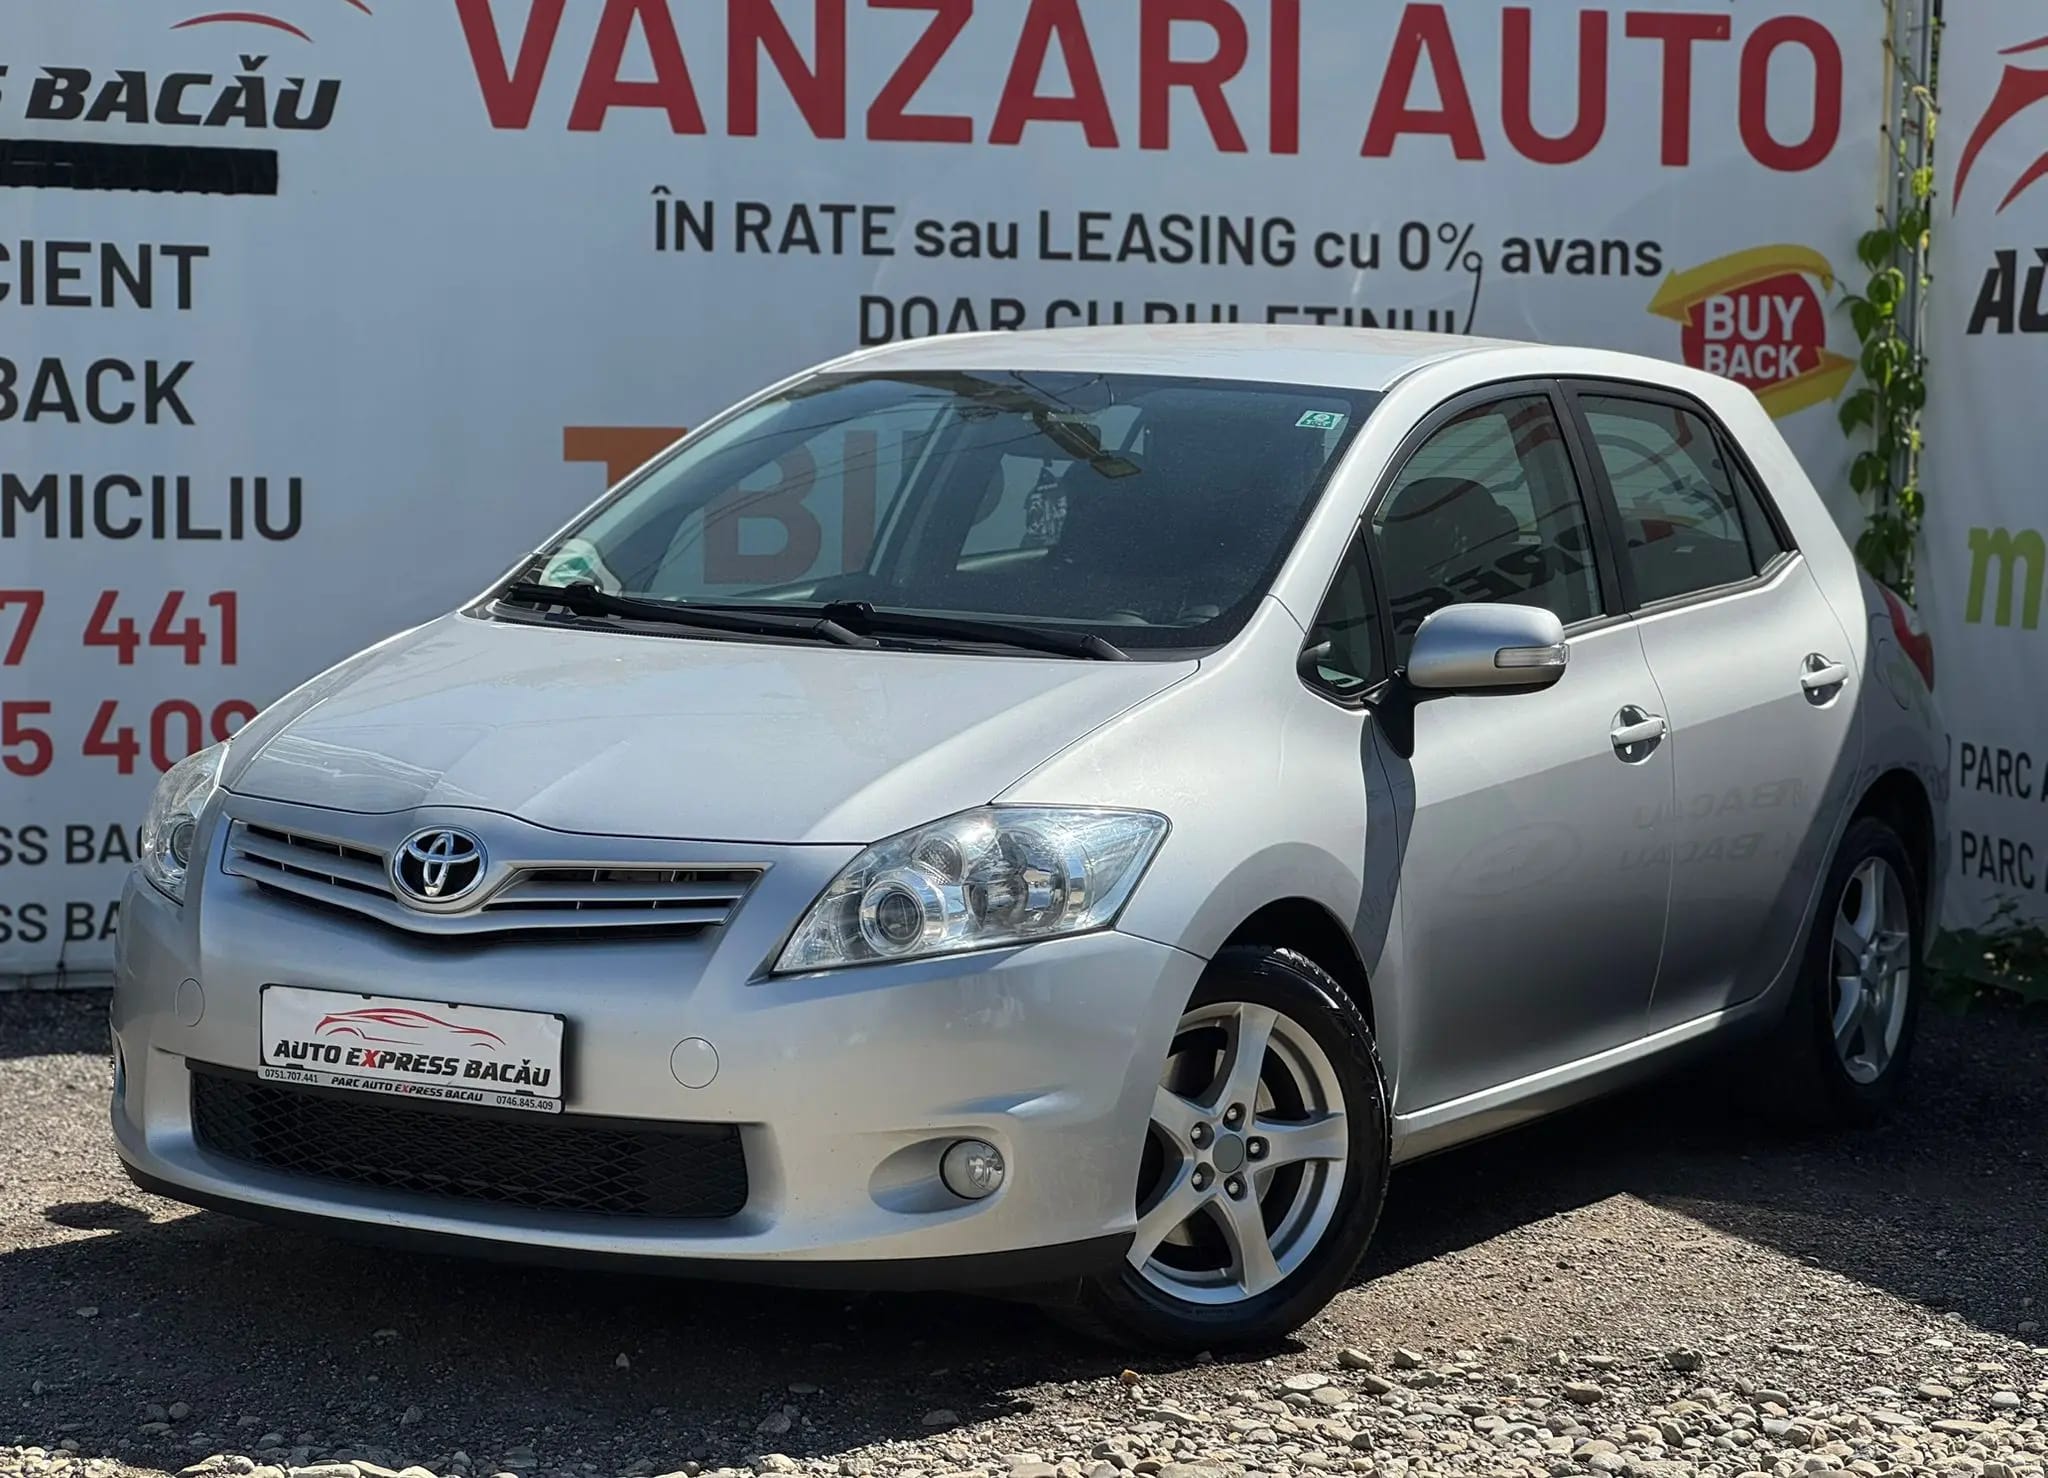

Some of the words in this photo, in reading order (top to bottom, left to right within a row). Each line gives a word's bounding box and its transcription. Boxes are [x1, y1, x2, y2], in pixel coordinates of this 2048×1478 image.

[25, 54, 341, 131] BACĂU
[452, 0, 1299, 155] VANZARI
[1360, 3, 1843, 173] AUTO
[650, 185, 715, 252] ÎN
[735, 201, 896, 256] RATE
[913, 218, 1018, 260] sau
[1038, 210, 1297, 268] LEASING
[1314, 229, 1380, 270] cu
[1399, 221, 1482, 274] 0%
[1501, 238, 1662, 277] avans
[0, 239, 209, 310] IENT
[859, 295, 1026, 346] DOAR
[1704, 294, 1805, 342] BUY
[1703, 343, 1803, 380] BACK
[2, 474, 302, 541] MICILIU
[0, 589, 44, 666] 7
[82, 590, 237, 666] 441
[2, 700, 53, 777] 5
[1960, 741, 2032, 799] PARC
[65, 822, 142, 865] BA
[1960, 829, 2035, 890] PARC
[264, 1068, 319, 1084] 0751.707.441
[331, 1076, 359, 1088] PARC
[362, 1080, 393, 1092] AUTO
[395, 1083, 443, 1097] EXPRESS
[496, 1095, 554, 1111] 0746.845.409
[273, 1039, 342, 1064] AUTO
[345, 1047, 460, 1077] EXPRESS
[463, 1058, 552, 1088] BACĂU
